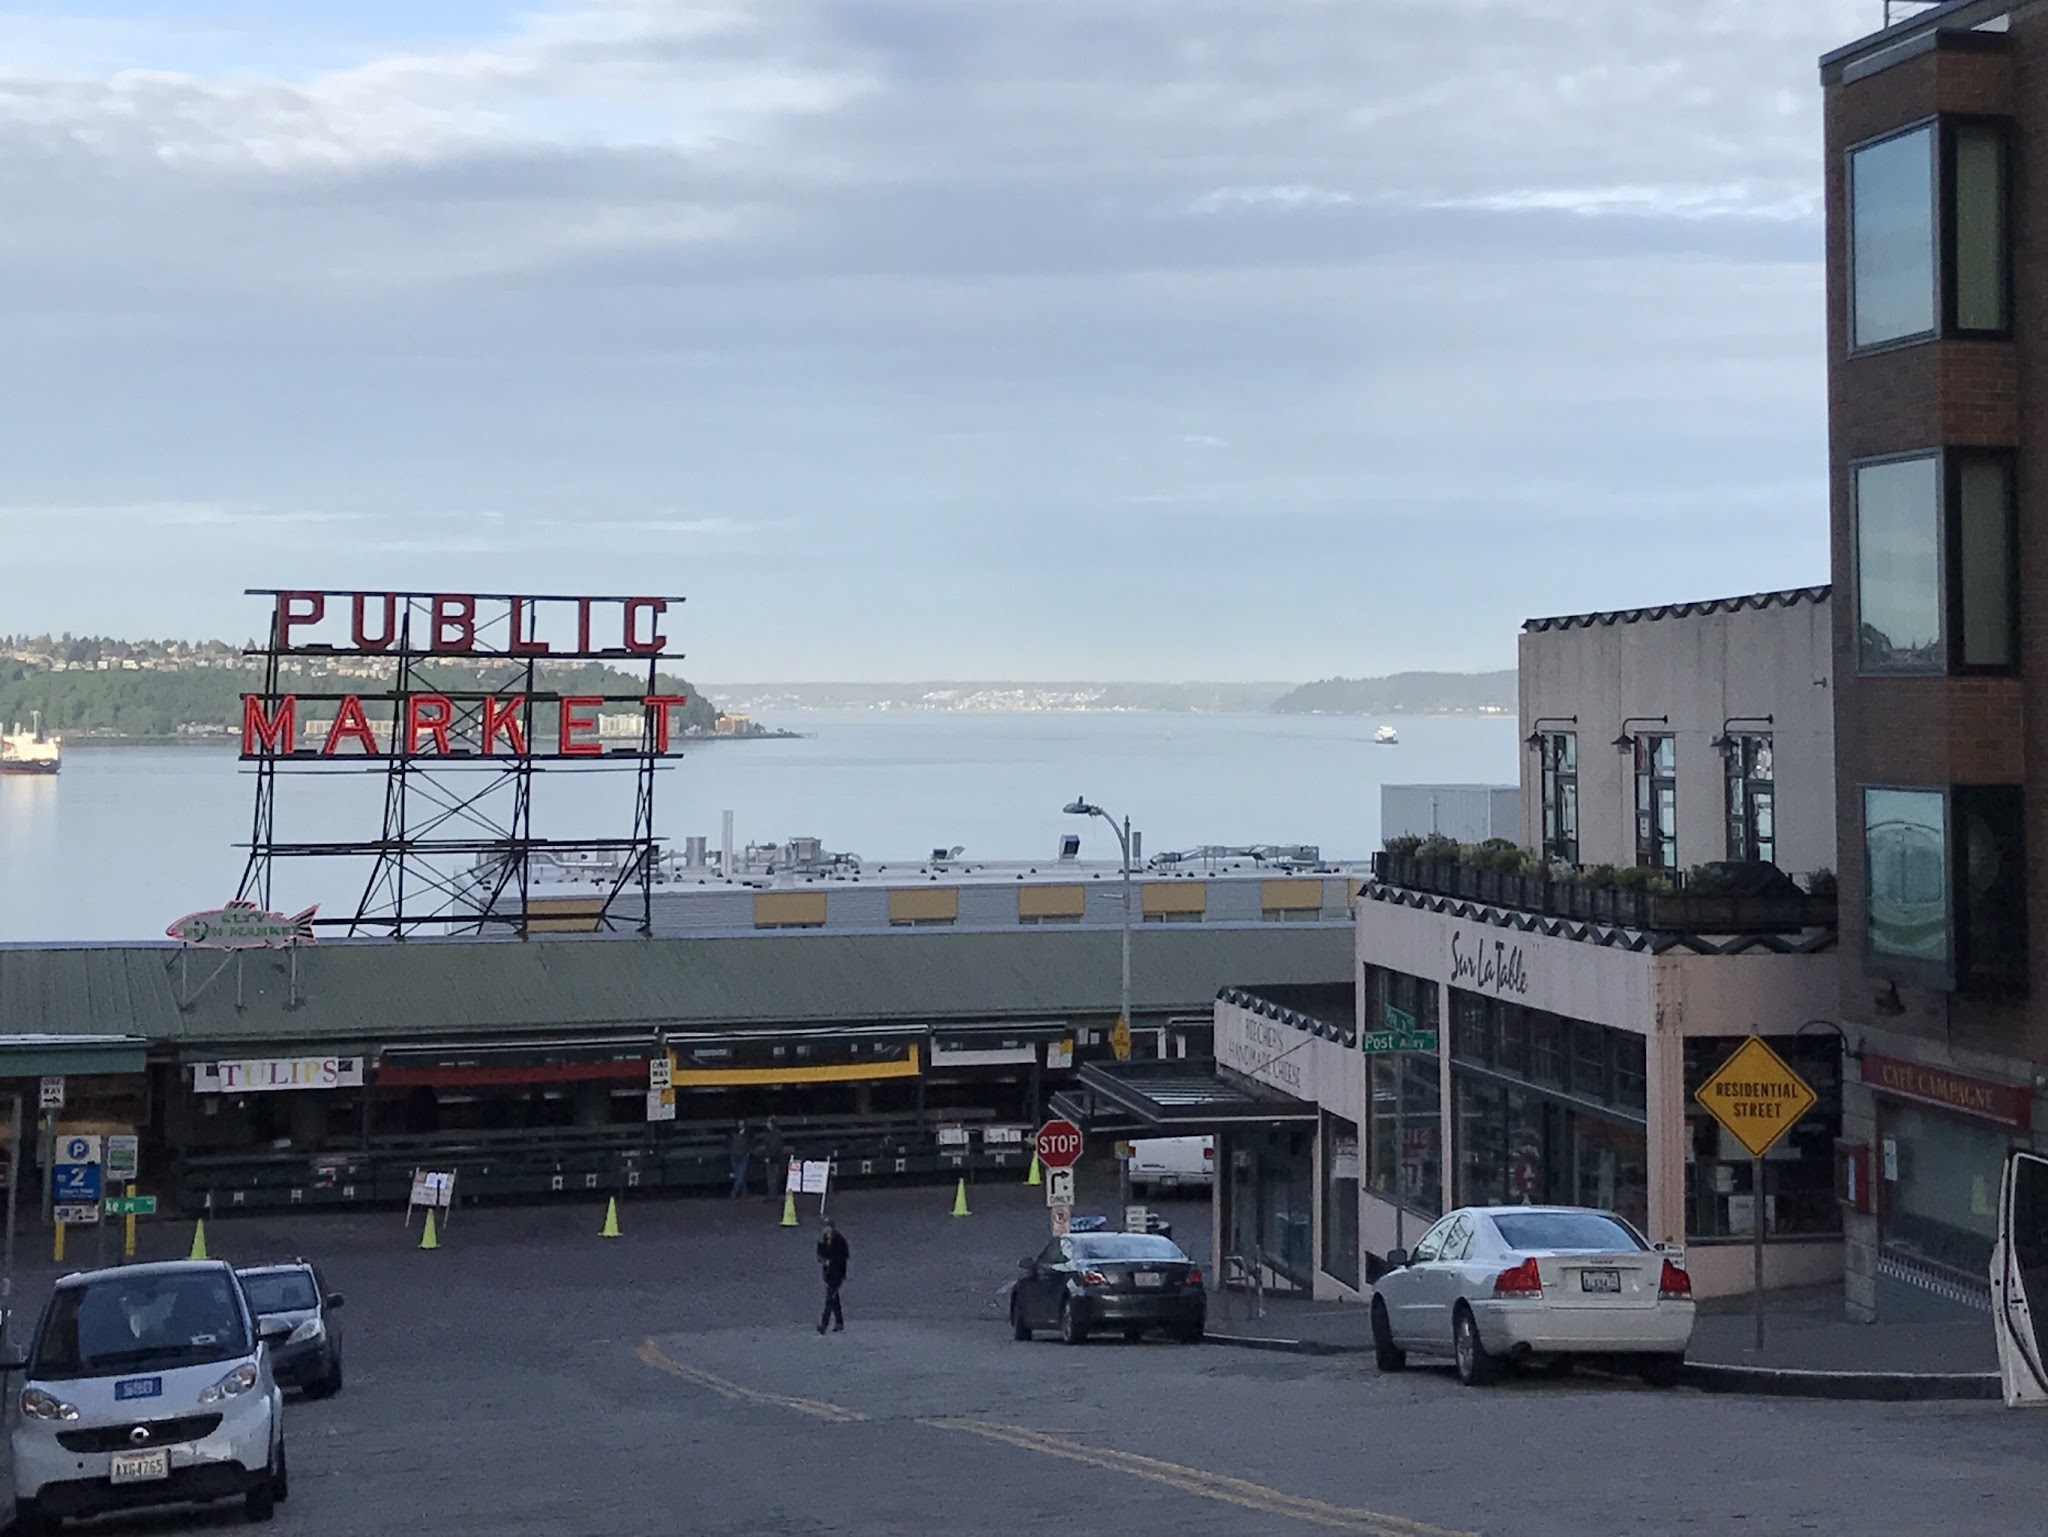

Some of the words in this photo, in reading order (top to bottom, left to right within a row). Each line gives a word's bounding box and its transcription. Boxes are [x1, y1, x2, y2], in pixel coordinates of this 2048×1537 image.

[276, 591, 667, 653] PUBLIC
[241, 693, 686, 755] MARKET
[1451, 930, 1476, 982] Sur
[1477, 938, 1495, 988] La
[1495, 940, 1529, 994] Table
[1365, 1033, 1393, 1049] Post
[219, 1060, 337, 1087] TULIPS
[1716, 1082, 1799, 1099] RESIDENTIAL
[1733, 1102, 1781, 1118] STREET
[1040, 1134, 1079, 1154] STOP
[70, 1167, 87, 1187] 2
[1049, 1195, 1072, 1204] ONLY
